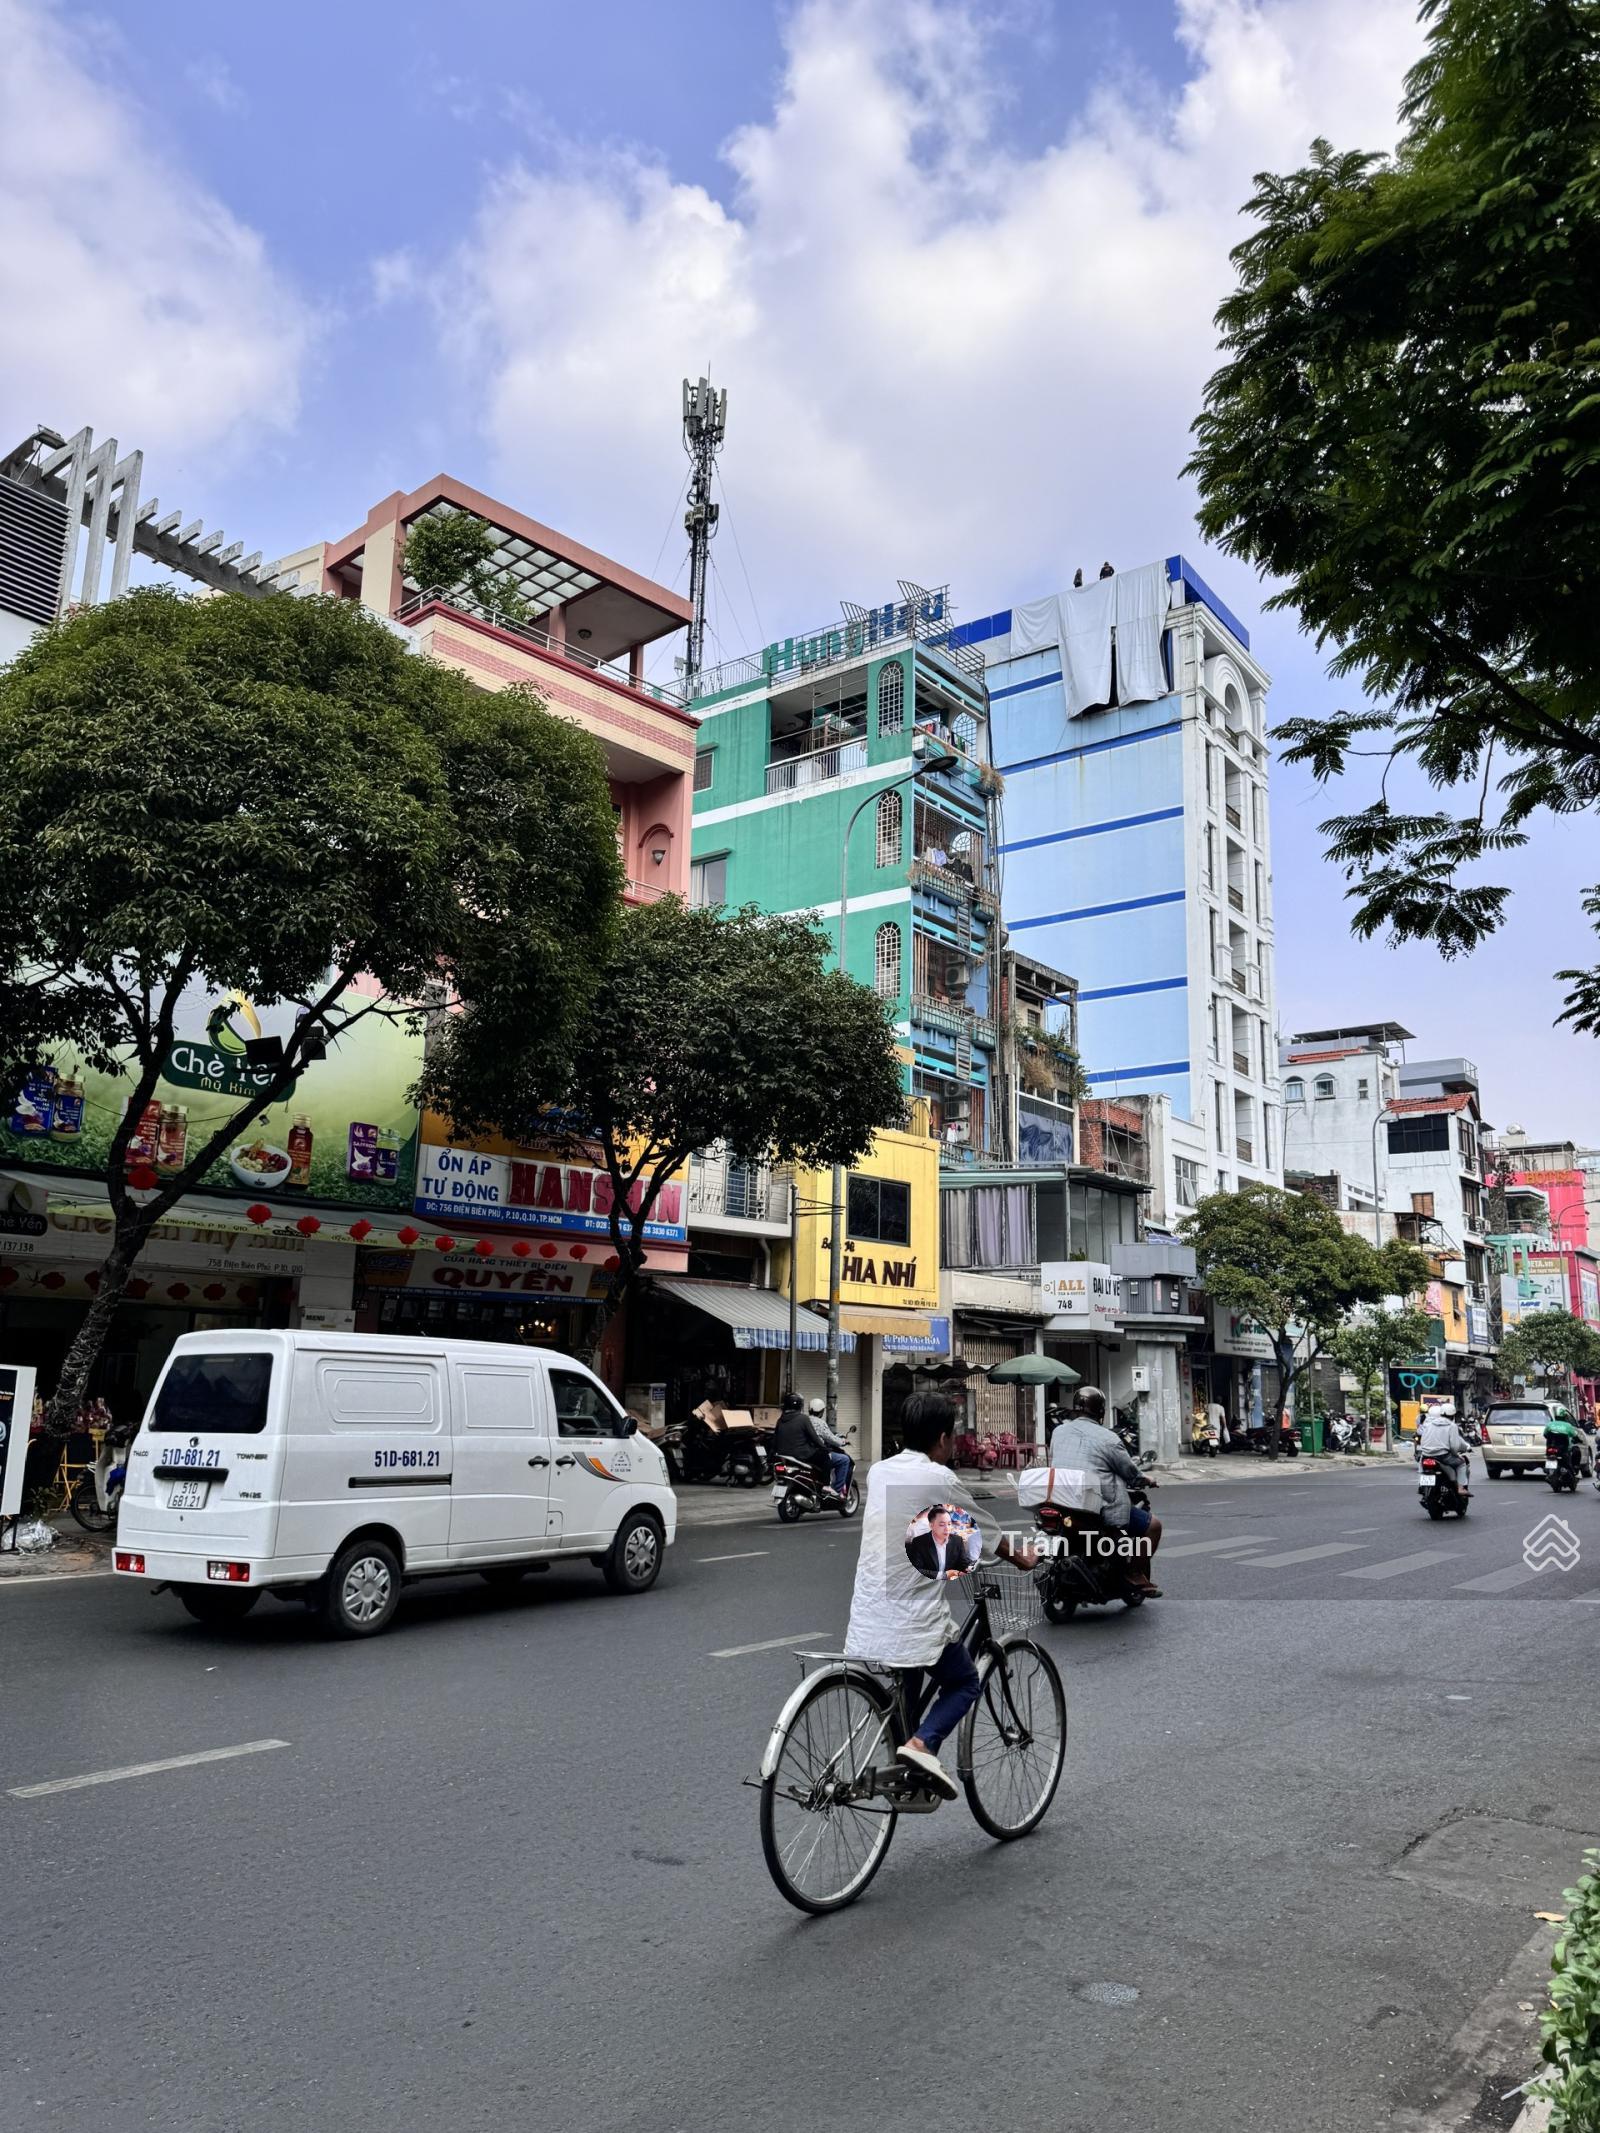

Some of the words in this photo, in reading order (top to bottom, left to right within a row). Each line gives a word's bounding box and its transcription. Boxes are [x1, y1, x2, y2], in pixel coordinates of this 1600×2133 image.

[171, 1047, 225, 1078] Chè
[229, 1081, 256, 1097] Kim
[437, 1149, 464, 1175] ỔN
[467, 1154, 492, 1176] ÁP
[422, 1176, 447, 1198] TỰ
[451, 1180, 499, 1202] ĐỘNG
[881, 1256, 918, 1289] NHÍ
[1058, 1279, 1086, 1291] ALL
[1093, 1277, 1104, 1297] ĐẠI
[1057, 1299, 1073, 1309] 748
[161, 1448, 221, 1468] 51D-681.21
[373, 1449, 441, 1468] 51D-681.21
[181, 1481, 198, 1494] 51D
[171, 1495, 201, 1508] 681.21
